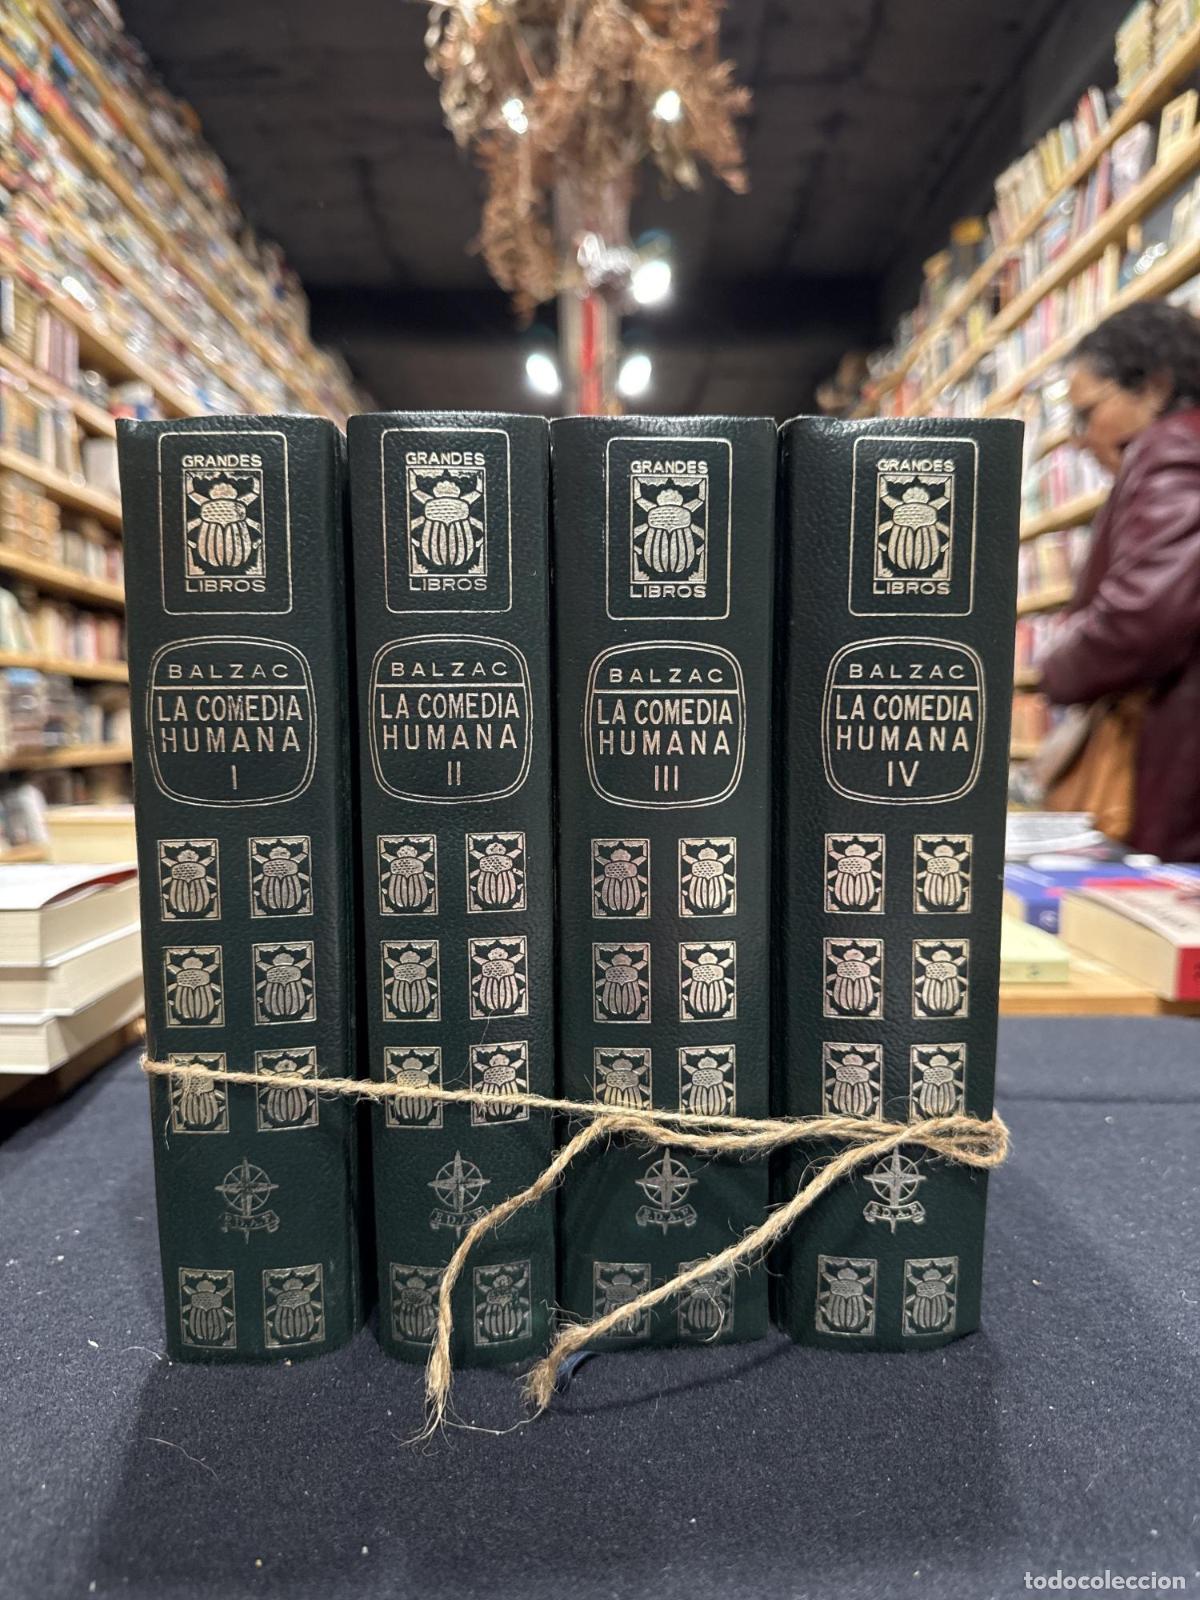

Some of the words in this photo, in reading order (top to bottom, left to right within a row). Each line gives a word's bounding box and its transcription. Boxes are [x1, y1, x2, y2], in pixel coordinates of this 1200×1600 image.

[181, 454, 263, 469] GRANDES
[405, 451, 486, 467] GRANDES
[629, 459, 709, 476] GRANDES
[876, 458, 956, 475] GRANDES
[185, 577, 267, 594] LIBROS
[408, 576, 488, 593] LIBROS
[629, 583, 707, 600] LIBROS
[871, 580, 951, 597] LIBROS
[168, 664, 289, 680] BALZAC
[391, 661, 508, 677] BALZAC
[609, 668, 724, 684] BALZAC
[848, 663, 966, 680] BALZAC
[158, 695, 189, 723] LA
[196, 694, 303, 722] COMEDIA
[380, 693, 410, 719] LA
[418, 692, 521, 719] COMEDIA
[597, 699, 627, 726] LA
[634, 699, 734, 726] COMEDIA
[835, 695, 865, 721] LA
[873, 694, 974, 722] COMEDIA
[161, 726, 302, 754] HUMANA
[383, 723, 518, 750] HUMANA
[599, 729, 731, 756] HUMANA
[836, 725, 970, 752] HUMANA
[231, 765, 238, 790] I
[446, 761, 461, 786] II
[654, 765, 679, 792] III
[887, 760, 919, 787] IV
